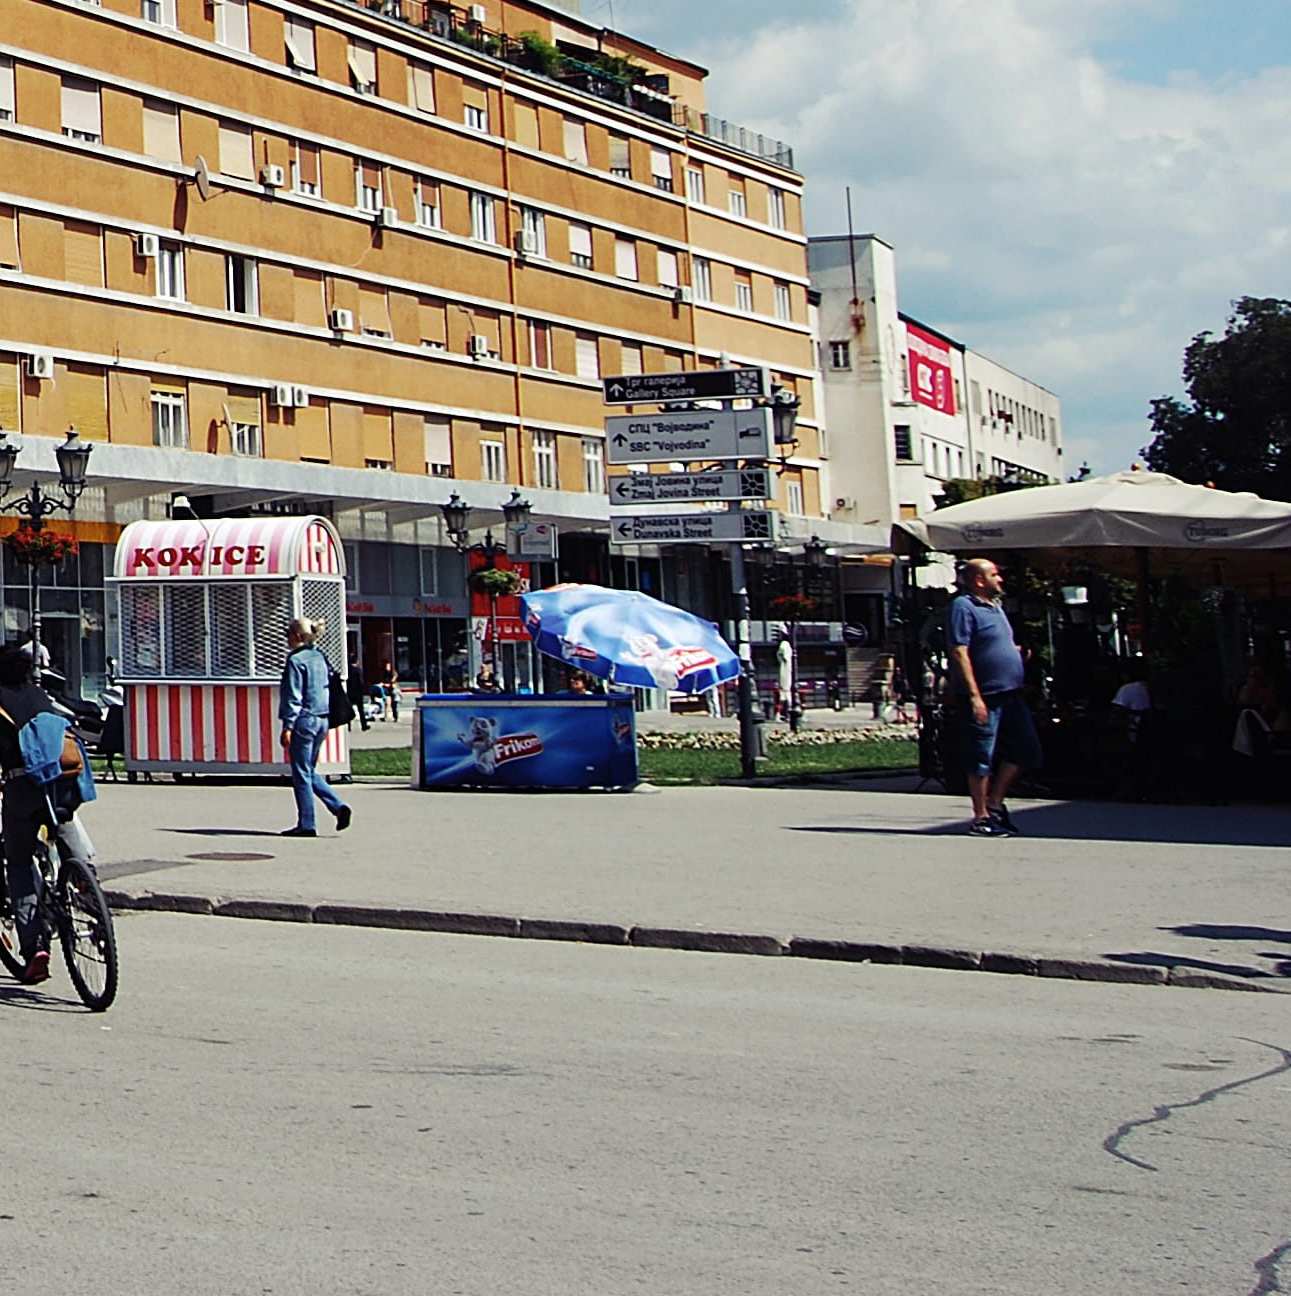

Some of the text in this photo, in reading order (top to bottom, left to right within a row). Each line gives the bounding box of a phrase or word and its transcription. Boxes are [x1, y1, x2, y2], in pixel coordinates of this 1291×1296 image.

[625, 386, 696, 399] Gallery Square
[629, 441, 651, 452] SBC
[631, 486, 721, 500] Zmaj Jovina Street
[633, 528, 713, 539] Dunavska Street
